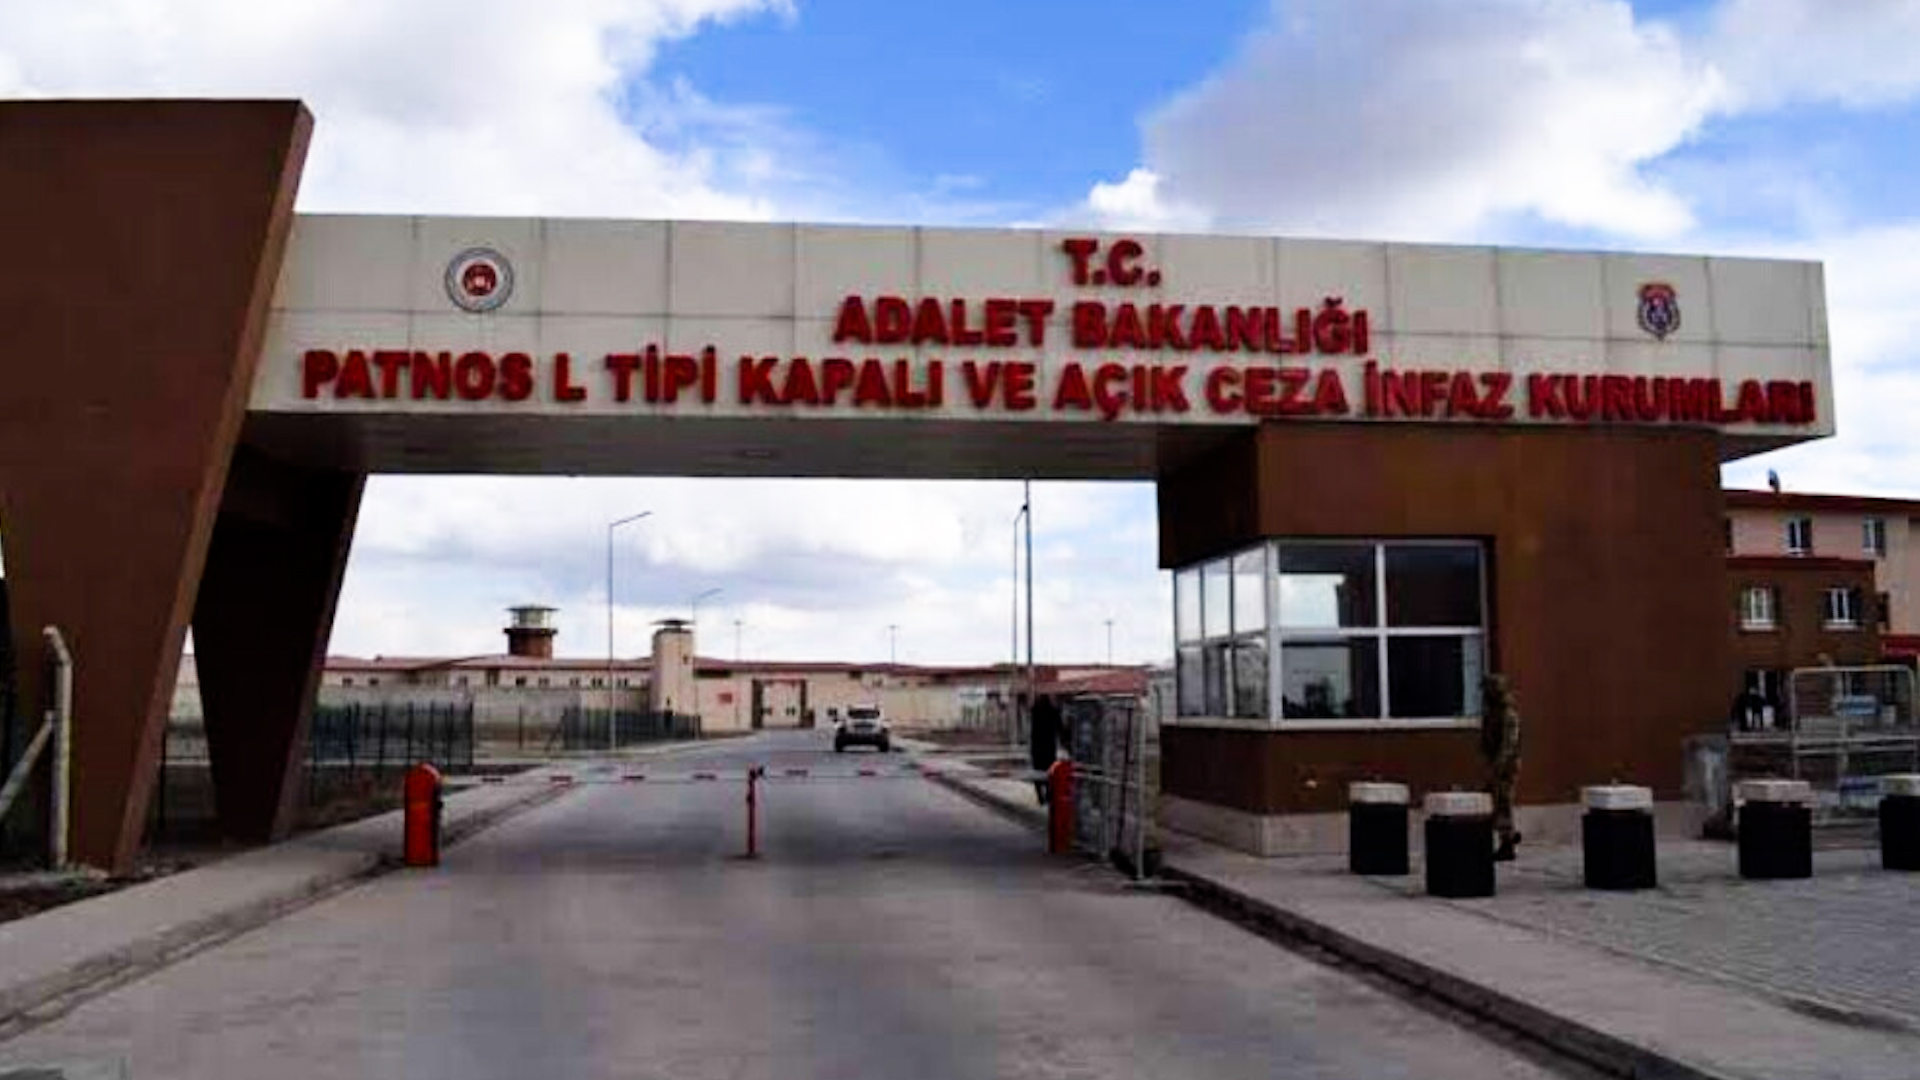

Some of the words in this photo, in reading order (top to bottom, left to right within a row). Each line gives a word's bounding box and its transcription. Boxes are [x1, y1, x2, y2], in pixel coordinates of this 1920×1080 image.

[1064, 238, 1160, 286] T.C.
[834, 296, 1054, 347] ADALET
[1072, 298, 1368, 355] BAKANLIĞI
[303, 350, 533, 400] PATNOS
[553, 353, 587, 400] L
[608, 344, 717, 402] TİPİ
[738, 356, 942, 406] KAPALI
[962, 360, 1036, 410] VE
[1053, 361, 1190, 420] AÇIK
[1205, 366, 1348, 416] CEZA
[1364, 361, 1513, 418] İNFAZ
[1529, 373, 1816, 423] KURUMLARI
